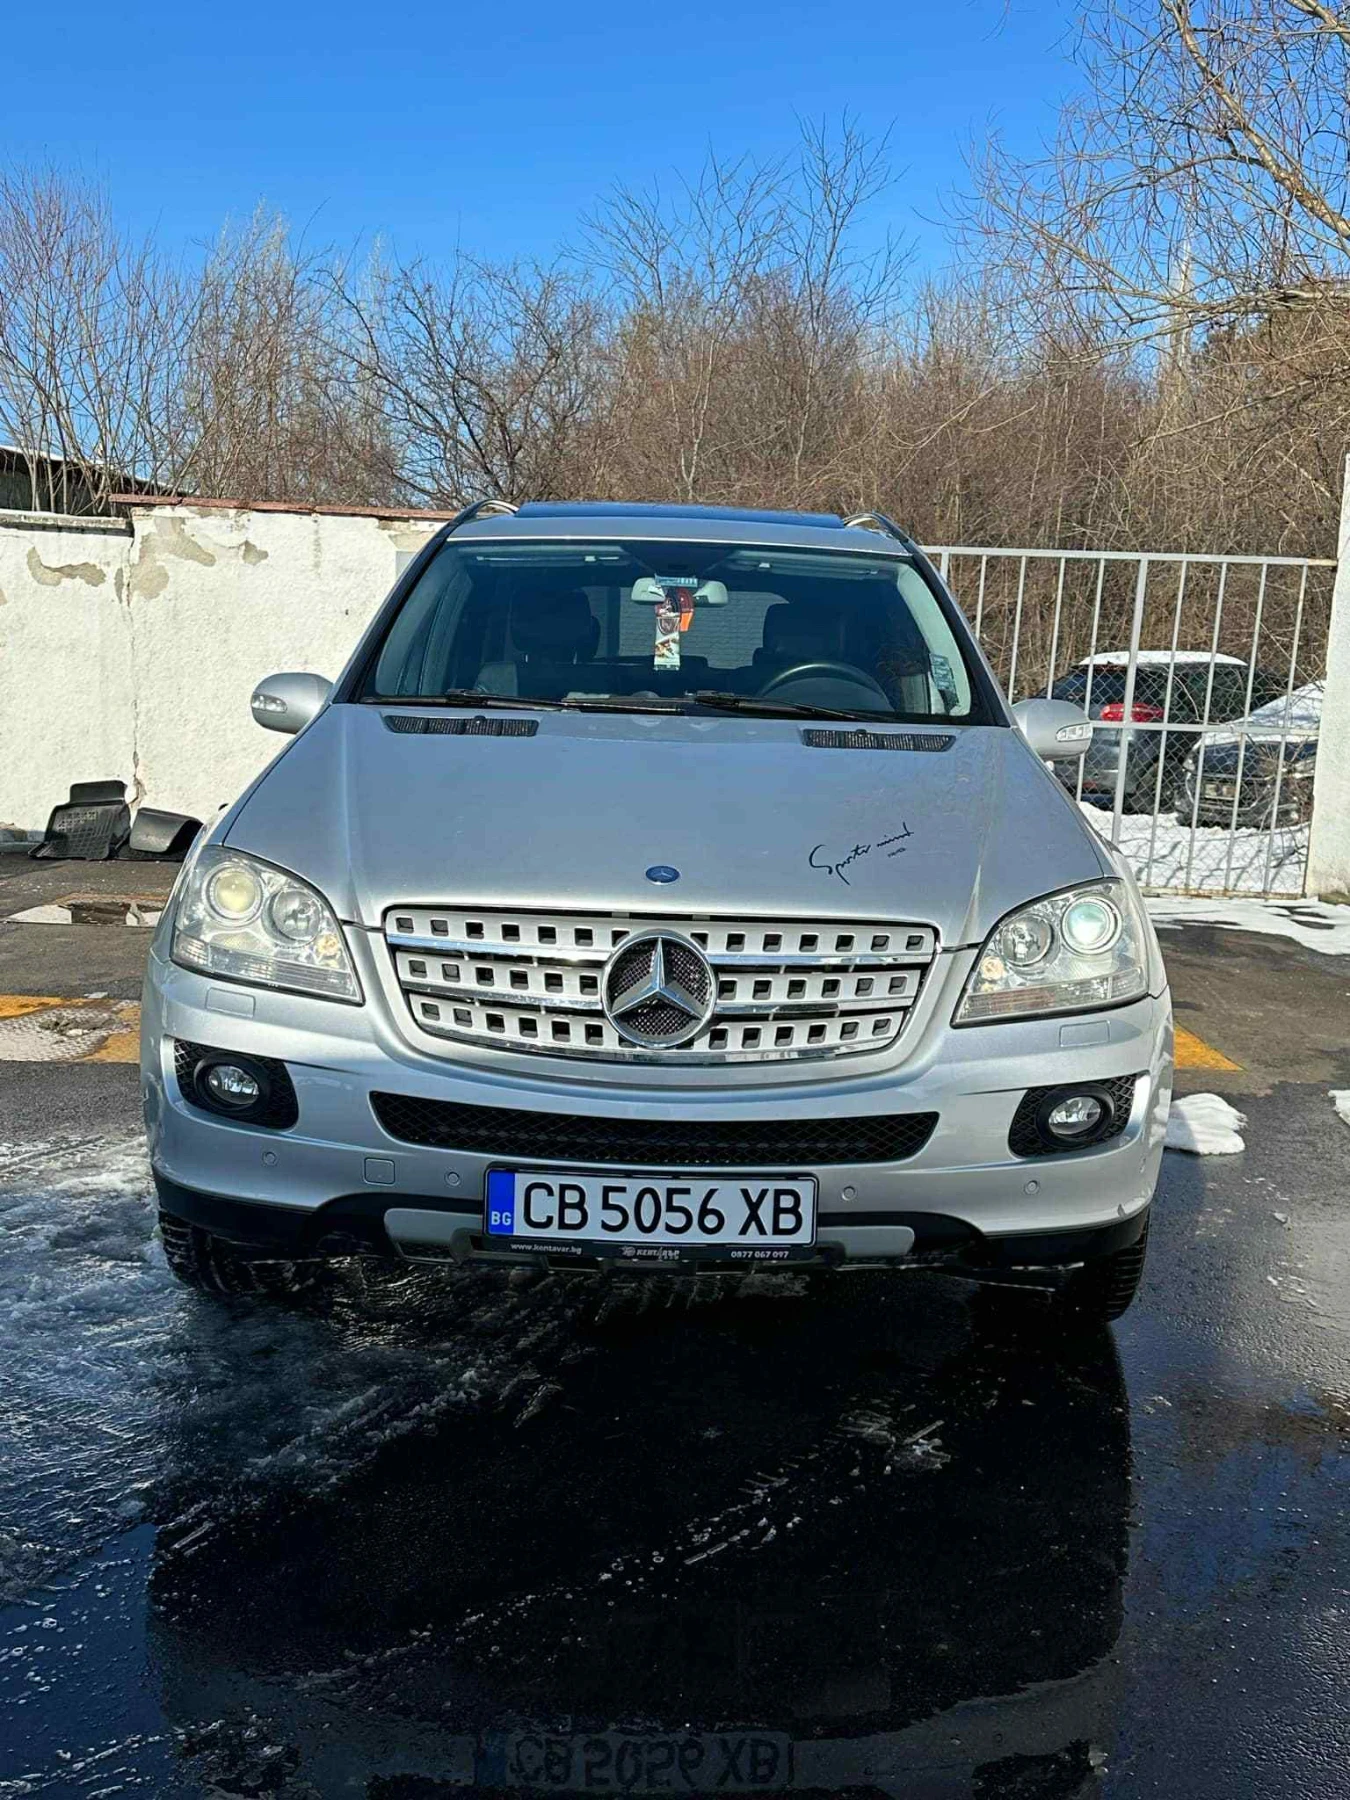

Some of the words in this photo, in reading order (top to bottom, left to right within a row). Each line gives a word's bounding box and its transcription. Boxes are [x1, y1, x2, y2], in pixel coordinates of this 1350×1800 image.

[523, 1182, 589, 1230] CB
[600, 1186, 725, 1235] 5056
[738, 1188, 803, 1236] XB
[490, 1211, 512, 1226] BG
[510, 1243, 582, 1255] www.kentavar.bg
